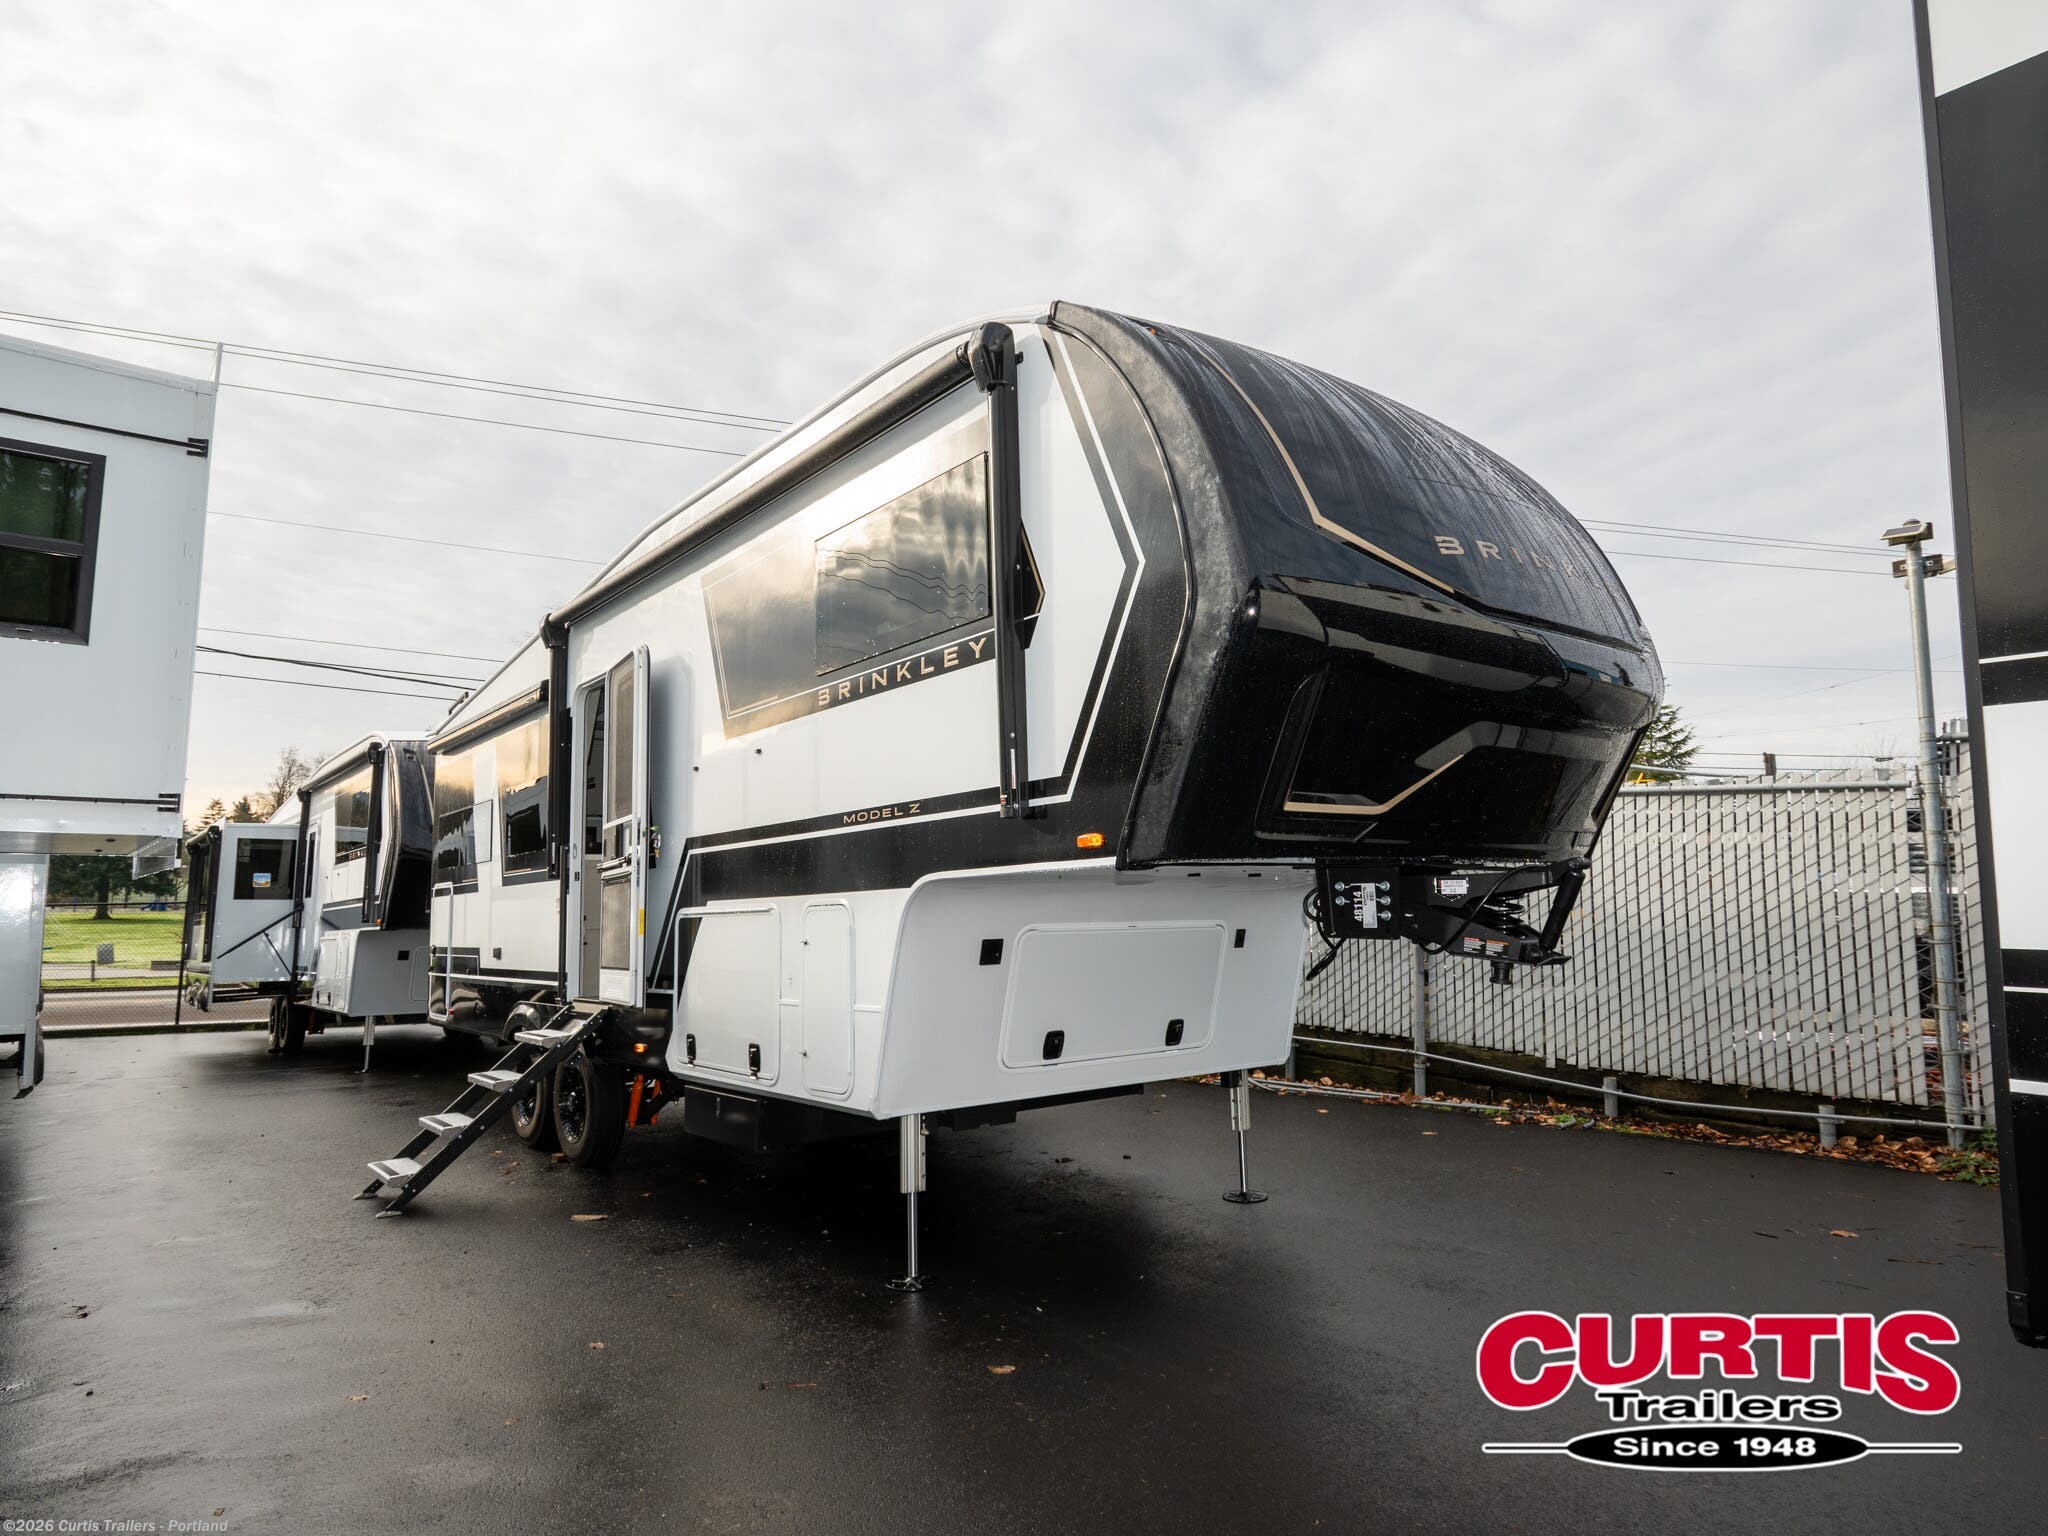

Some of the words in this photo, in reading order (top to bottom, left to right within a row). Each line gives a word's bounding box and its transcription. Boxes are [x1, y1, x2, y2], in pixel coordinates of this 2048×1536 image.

[818, 637, 987, 707] BRINKLEY
[843, 806, 904, 825] MODEL
[908, 802, 921, 815] Z
[1352, 890, 1363, 922] 48114
